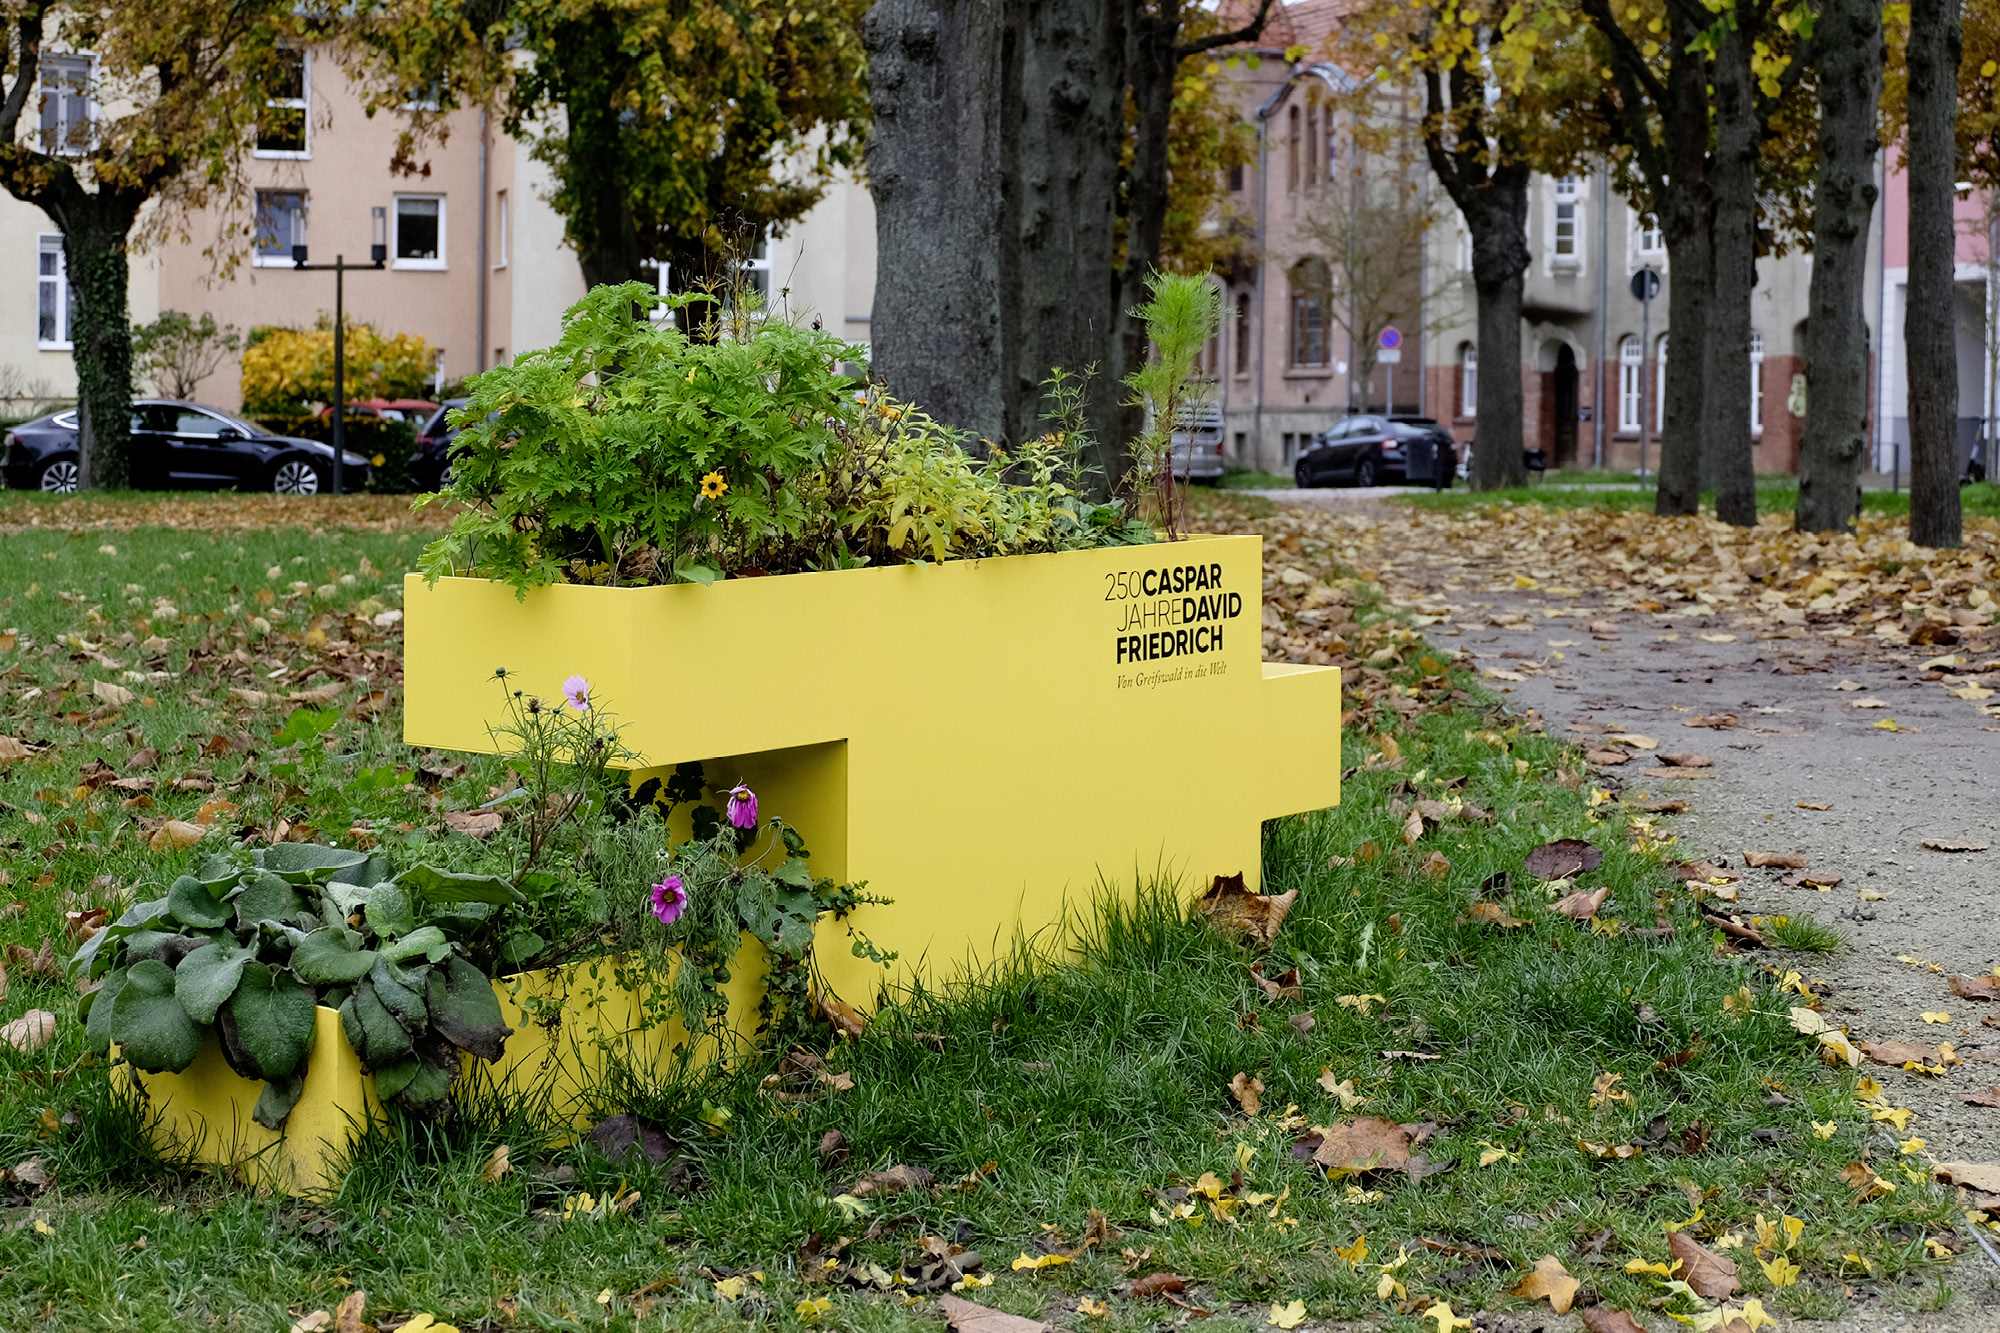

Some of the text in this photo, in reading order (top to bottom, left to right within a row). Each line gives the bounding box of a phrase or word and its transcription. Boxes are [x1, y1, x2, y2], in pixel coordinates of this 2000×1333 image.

[1116, 624, 1223, 665] FRIEDRICH
[1117, 660, 1227, 690] Von Greifswald in die Welt
